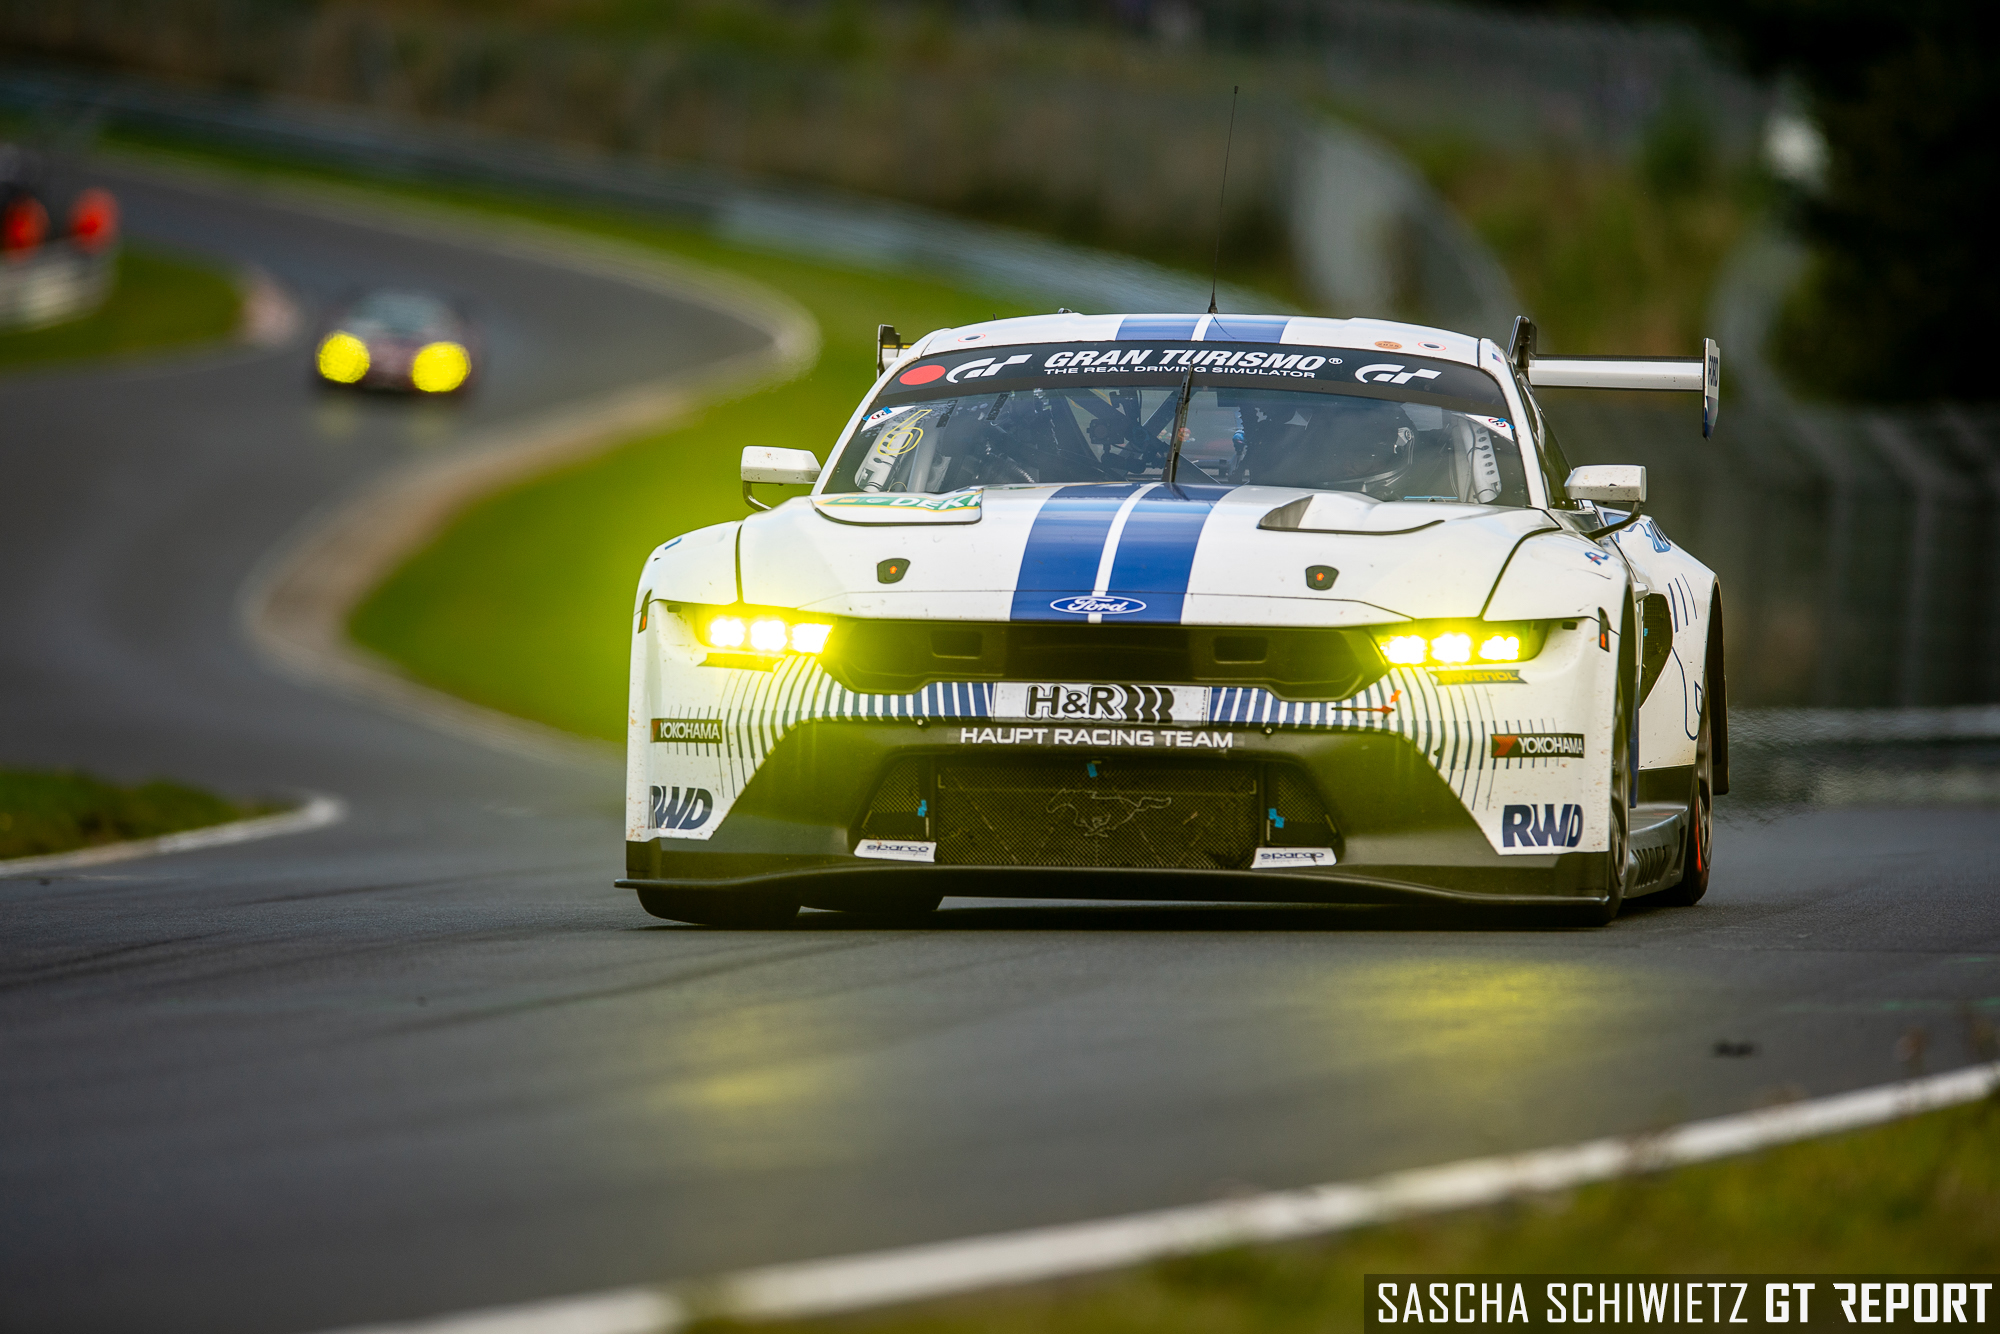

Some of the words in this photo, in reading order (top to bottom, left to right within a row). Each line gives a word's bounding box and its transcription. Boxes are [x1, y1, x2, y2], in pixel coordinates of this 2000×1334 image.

[1044, 350, 1152, 368] GRAN
[1083, 366, 1127, 374] REAL
[1212, 367, 1315, 378] SIMULATOR
[1067, 598, 1129, 612] Ford
[1027, 685, 1125, 720] H&R
[660, 722, 720, 739] YOKOHAMA
[960, 728, 1048, 744] HAUPT
[1054, 729, 1154, 746] RACING
[1160, 731, 1233, 748] TEAM
[1518, 737, 1584, 754] YOKOHAMA
[1502, 804, 1584, 848] RWD
